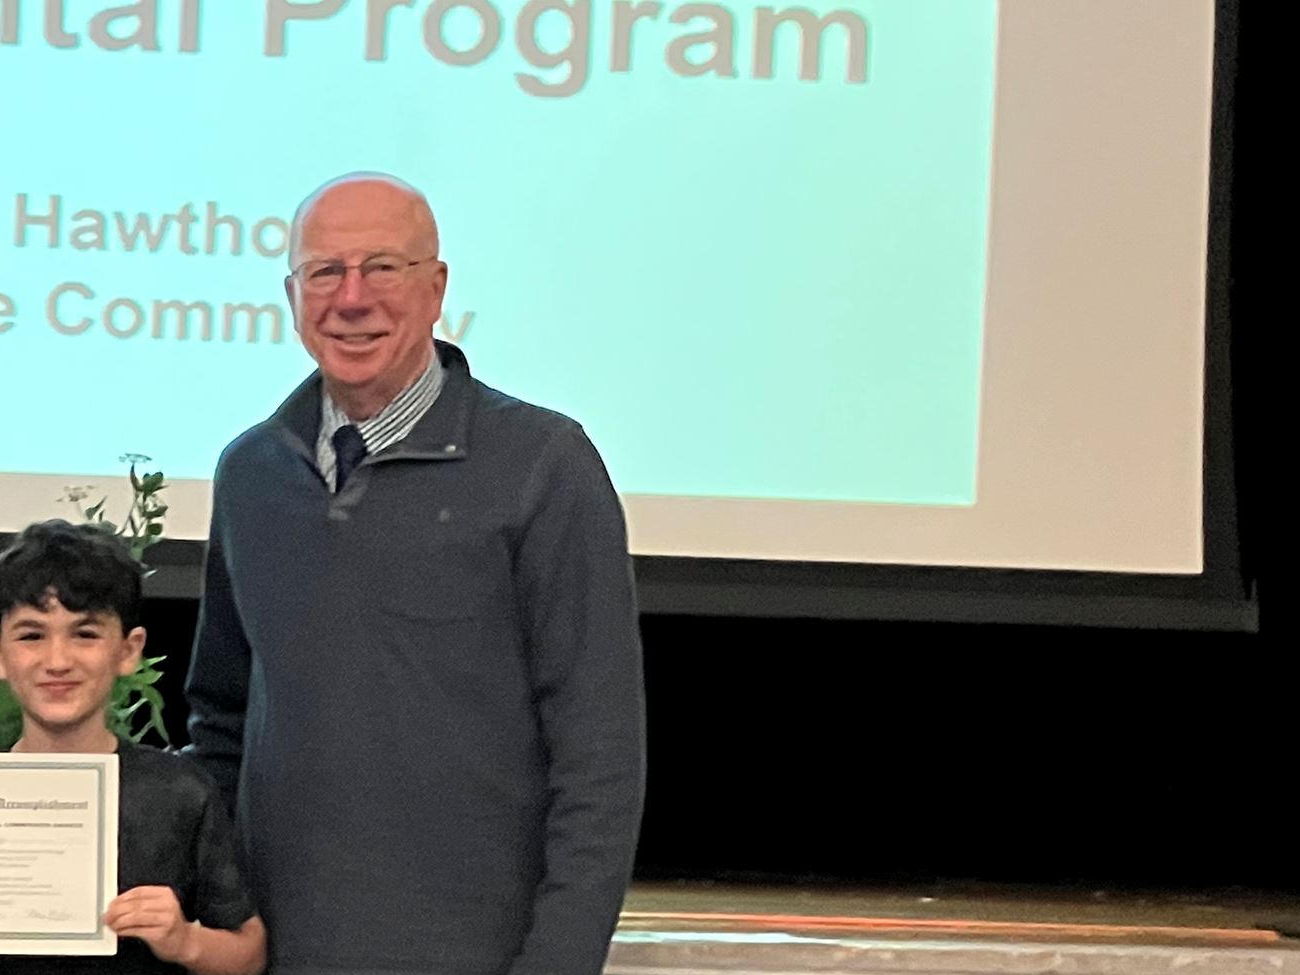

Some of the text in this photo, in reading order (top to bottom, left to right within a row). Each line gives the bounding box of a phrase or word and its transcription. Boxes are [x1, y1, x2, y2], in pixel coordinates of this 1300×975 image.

[264, 0, 869, 98] Program
[14, 193, 289, 258] Hawtho
[46, 281, 476, 344] Commy
